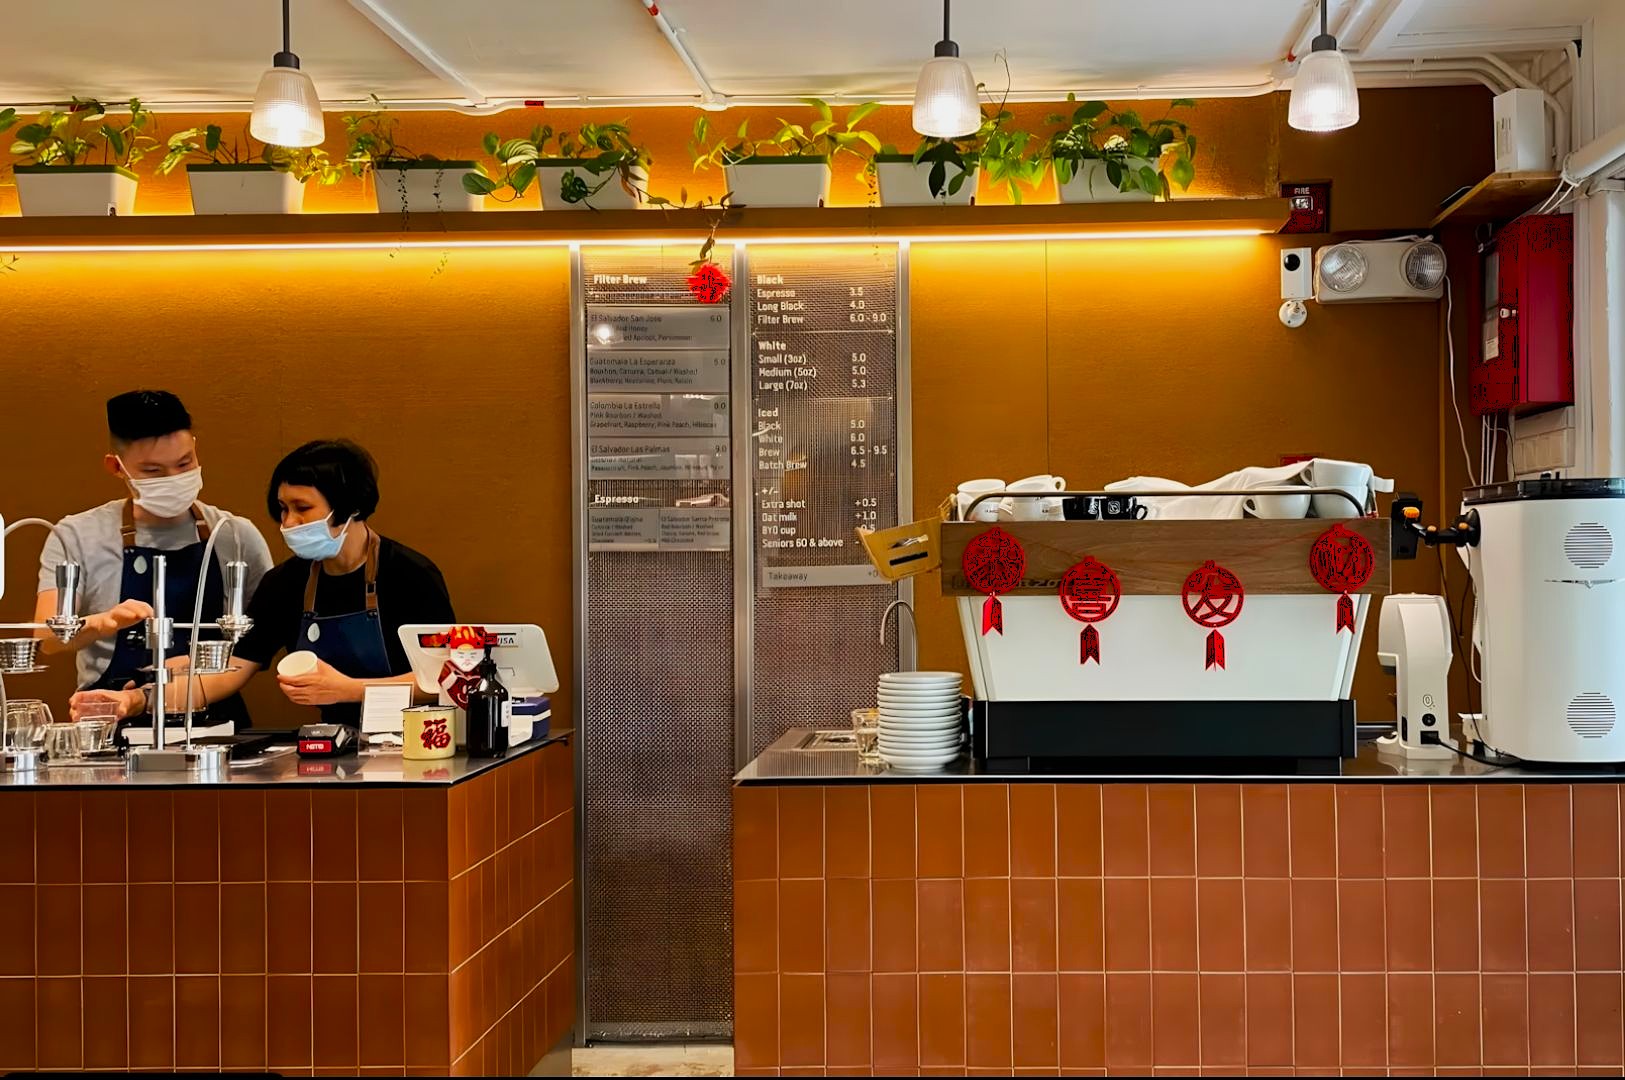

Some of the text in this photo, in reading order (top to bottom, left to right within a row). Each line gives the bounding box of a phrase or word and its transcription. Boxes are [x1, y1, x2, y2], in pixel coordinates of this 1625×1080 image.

[1294, 187, 1310, 195] FIRE
[593, 274, 648, 284] Filter Brew
[757, 274, 784, 285] Black
[757, 288, 796, 300] Espresso
[757, 300, 864, 312] Long Black 4.0
[758, 315, 780, 324] Filter
[782, 314, 804, 324] Brew
[850, 313, 864, 322] 6.0
[872, 313, 886, 322] 9.0
[758, 341, 786, 350] White
[759, 352, 866, 365] Small (3oz) 5.0
[759, 366, 866, 378] Medium (5oz) 5.0
[759, 381, 784, 392] Large
[785, 381, 808, 392] (7oz)
[758, 407, 778, 417] Iced
[758, 420, 865, 430] Black 5.0
[759, 434, 783, 443] White
[759, 447, 780, 457] Brew
[850, 445, 865, 455] 6.5
[873, 445, 887, 455] 9.5
[759, 459, 866, 470] Batch Brew 4.5
[594, 494, 639, 505] Espresso
[762, 500, 784, 509] Extra
[786, 499, 806, 508] shot
[762, 512, 777, 522] Oat
[779, 512, 797, 522] milk
[762, 526, 778, 535] BYO
[780, 527, 796, 536] cup
[762, 537, 844, 548] Seniors 60 & above
[768, 572, 808, 581] Takeaway
[421, 718, 451, 750] 福
